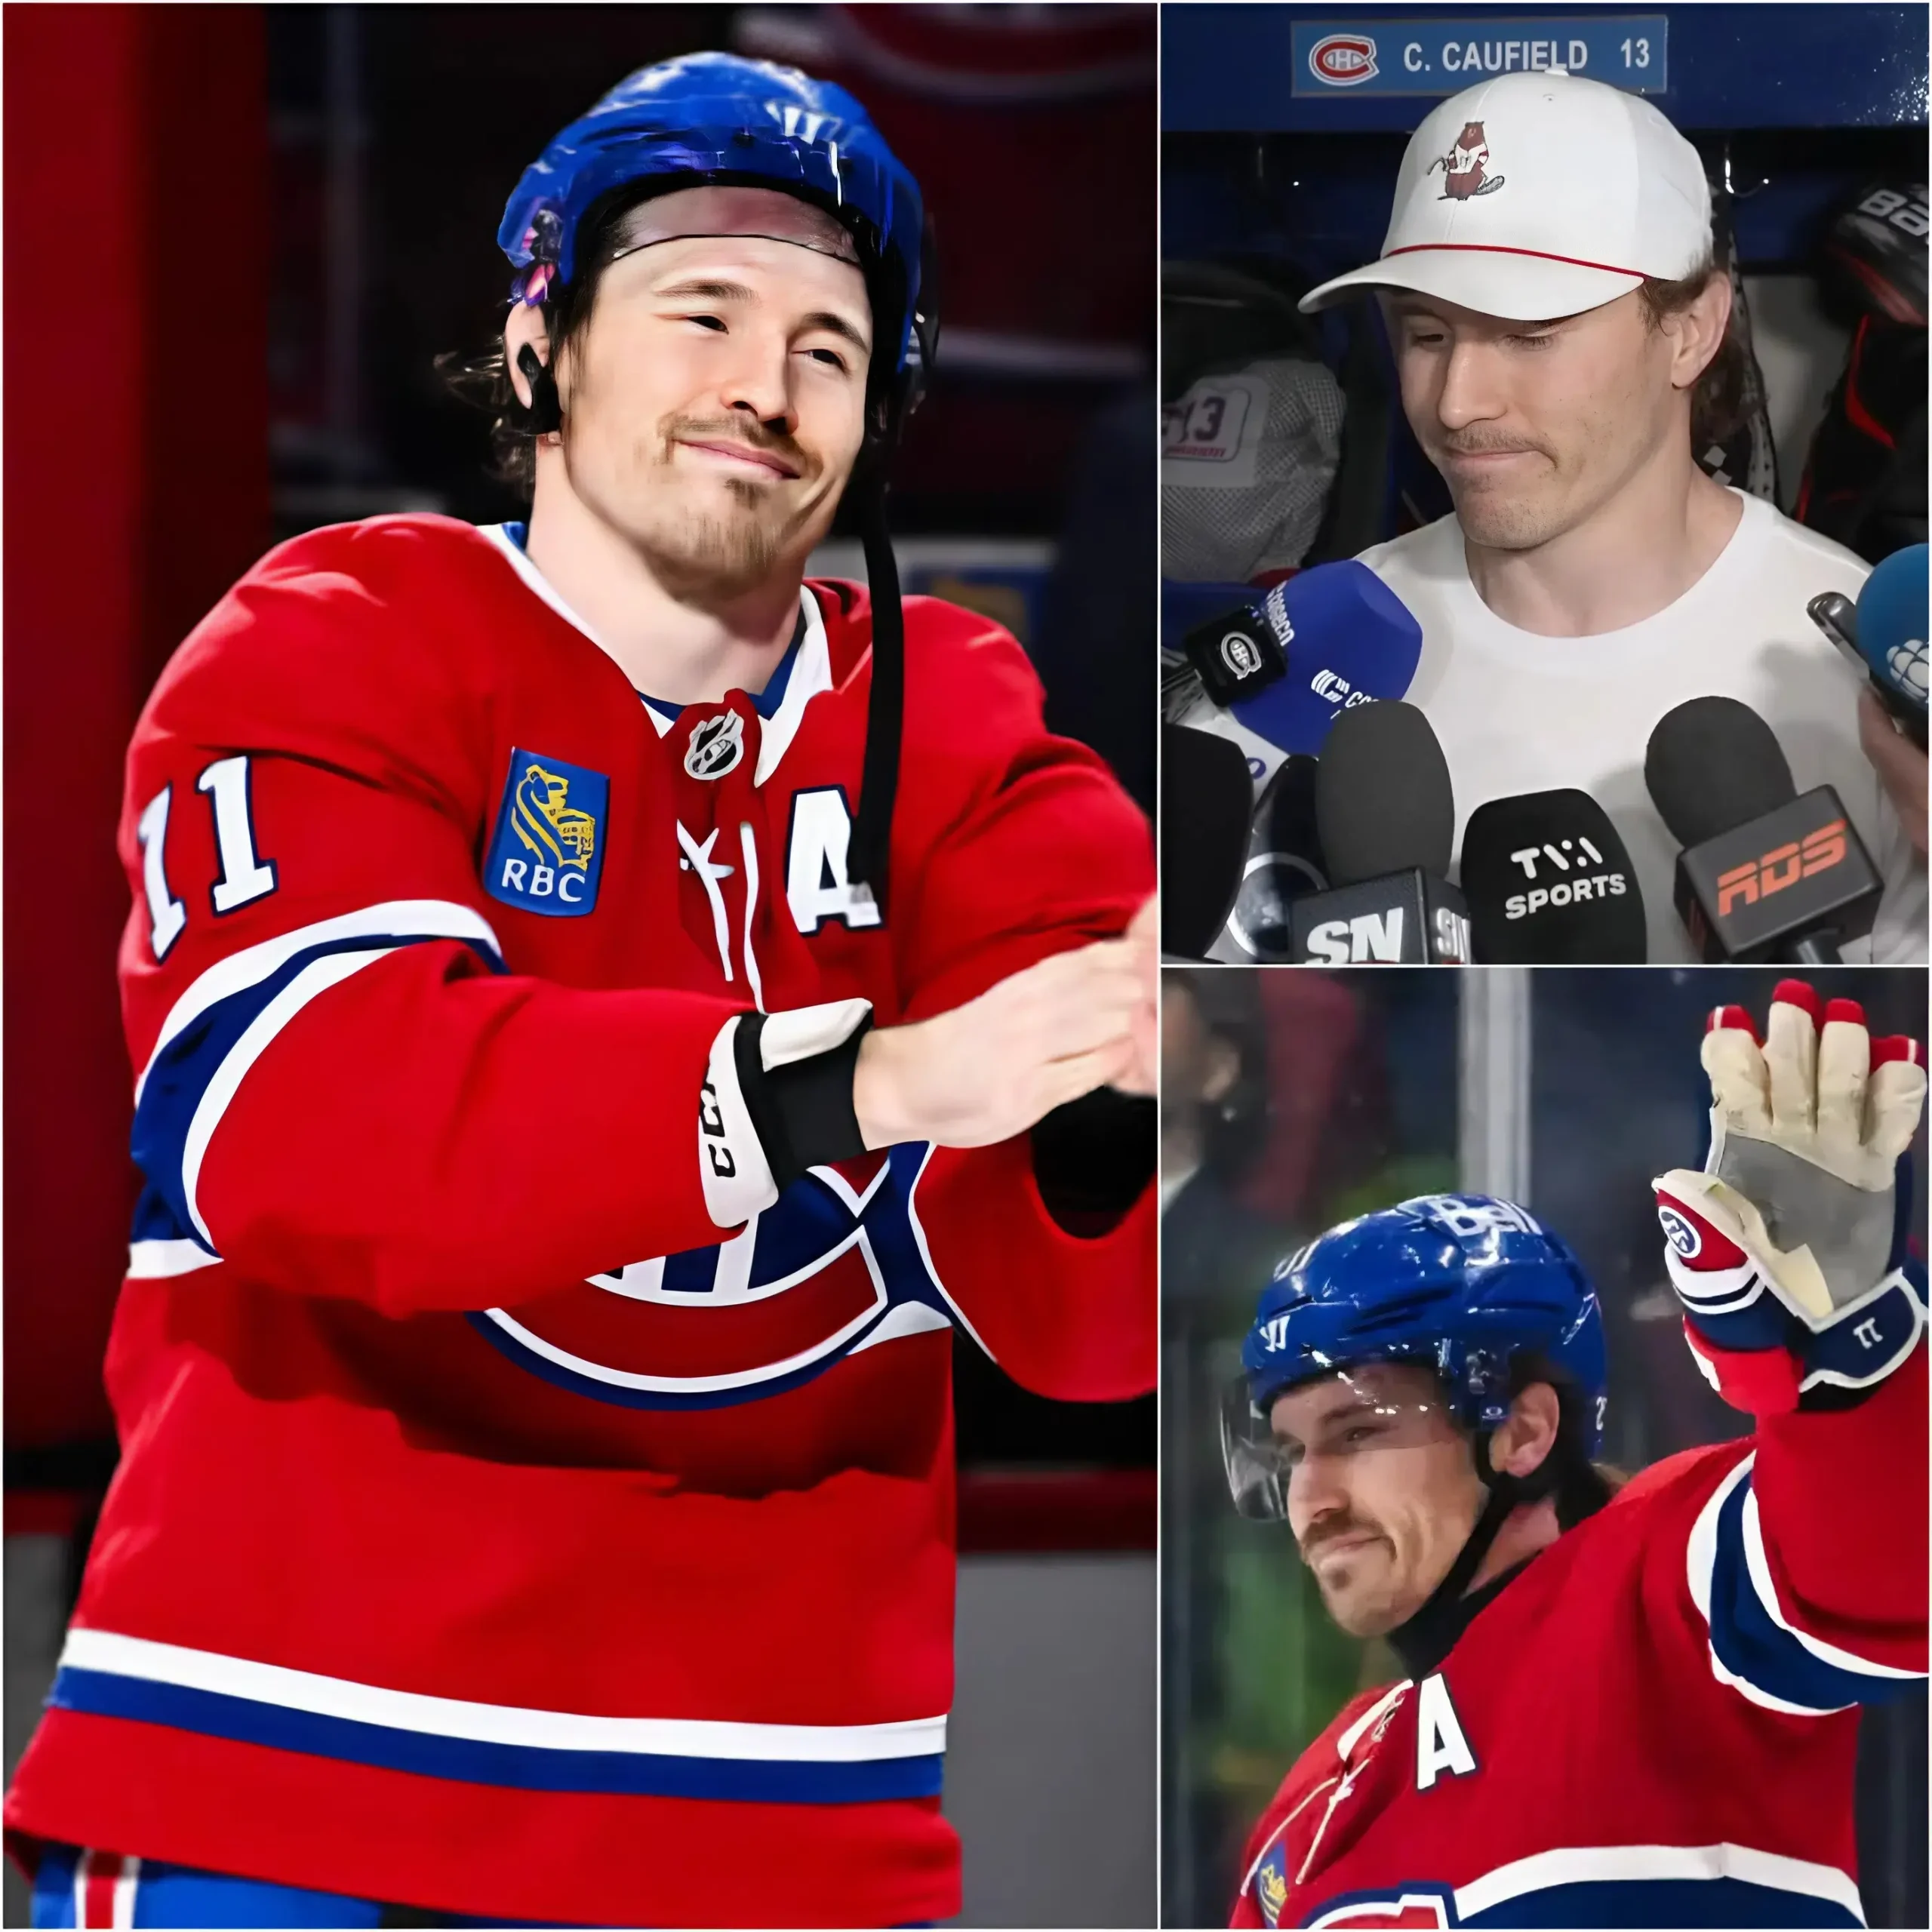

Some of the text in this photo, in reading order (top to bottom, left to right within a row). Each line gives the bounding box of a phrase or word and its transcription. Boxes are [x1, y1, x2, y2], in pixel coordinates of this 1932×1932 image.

[1404, 38, 1650, 72] C. CAUFIELD 13
[1857, 189, 1929, 243] Ba
[139, 755, 275, 960] 11
[501, 858, 586, 903] RBC
[787, 789, 881, 934] A
[1506, 873, 1626, 920] SPORTS
[1305, 907, 1405, 964] SN
[1417, 1672, 1476, 1790] A
